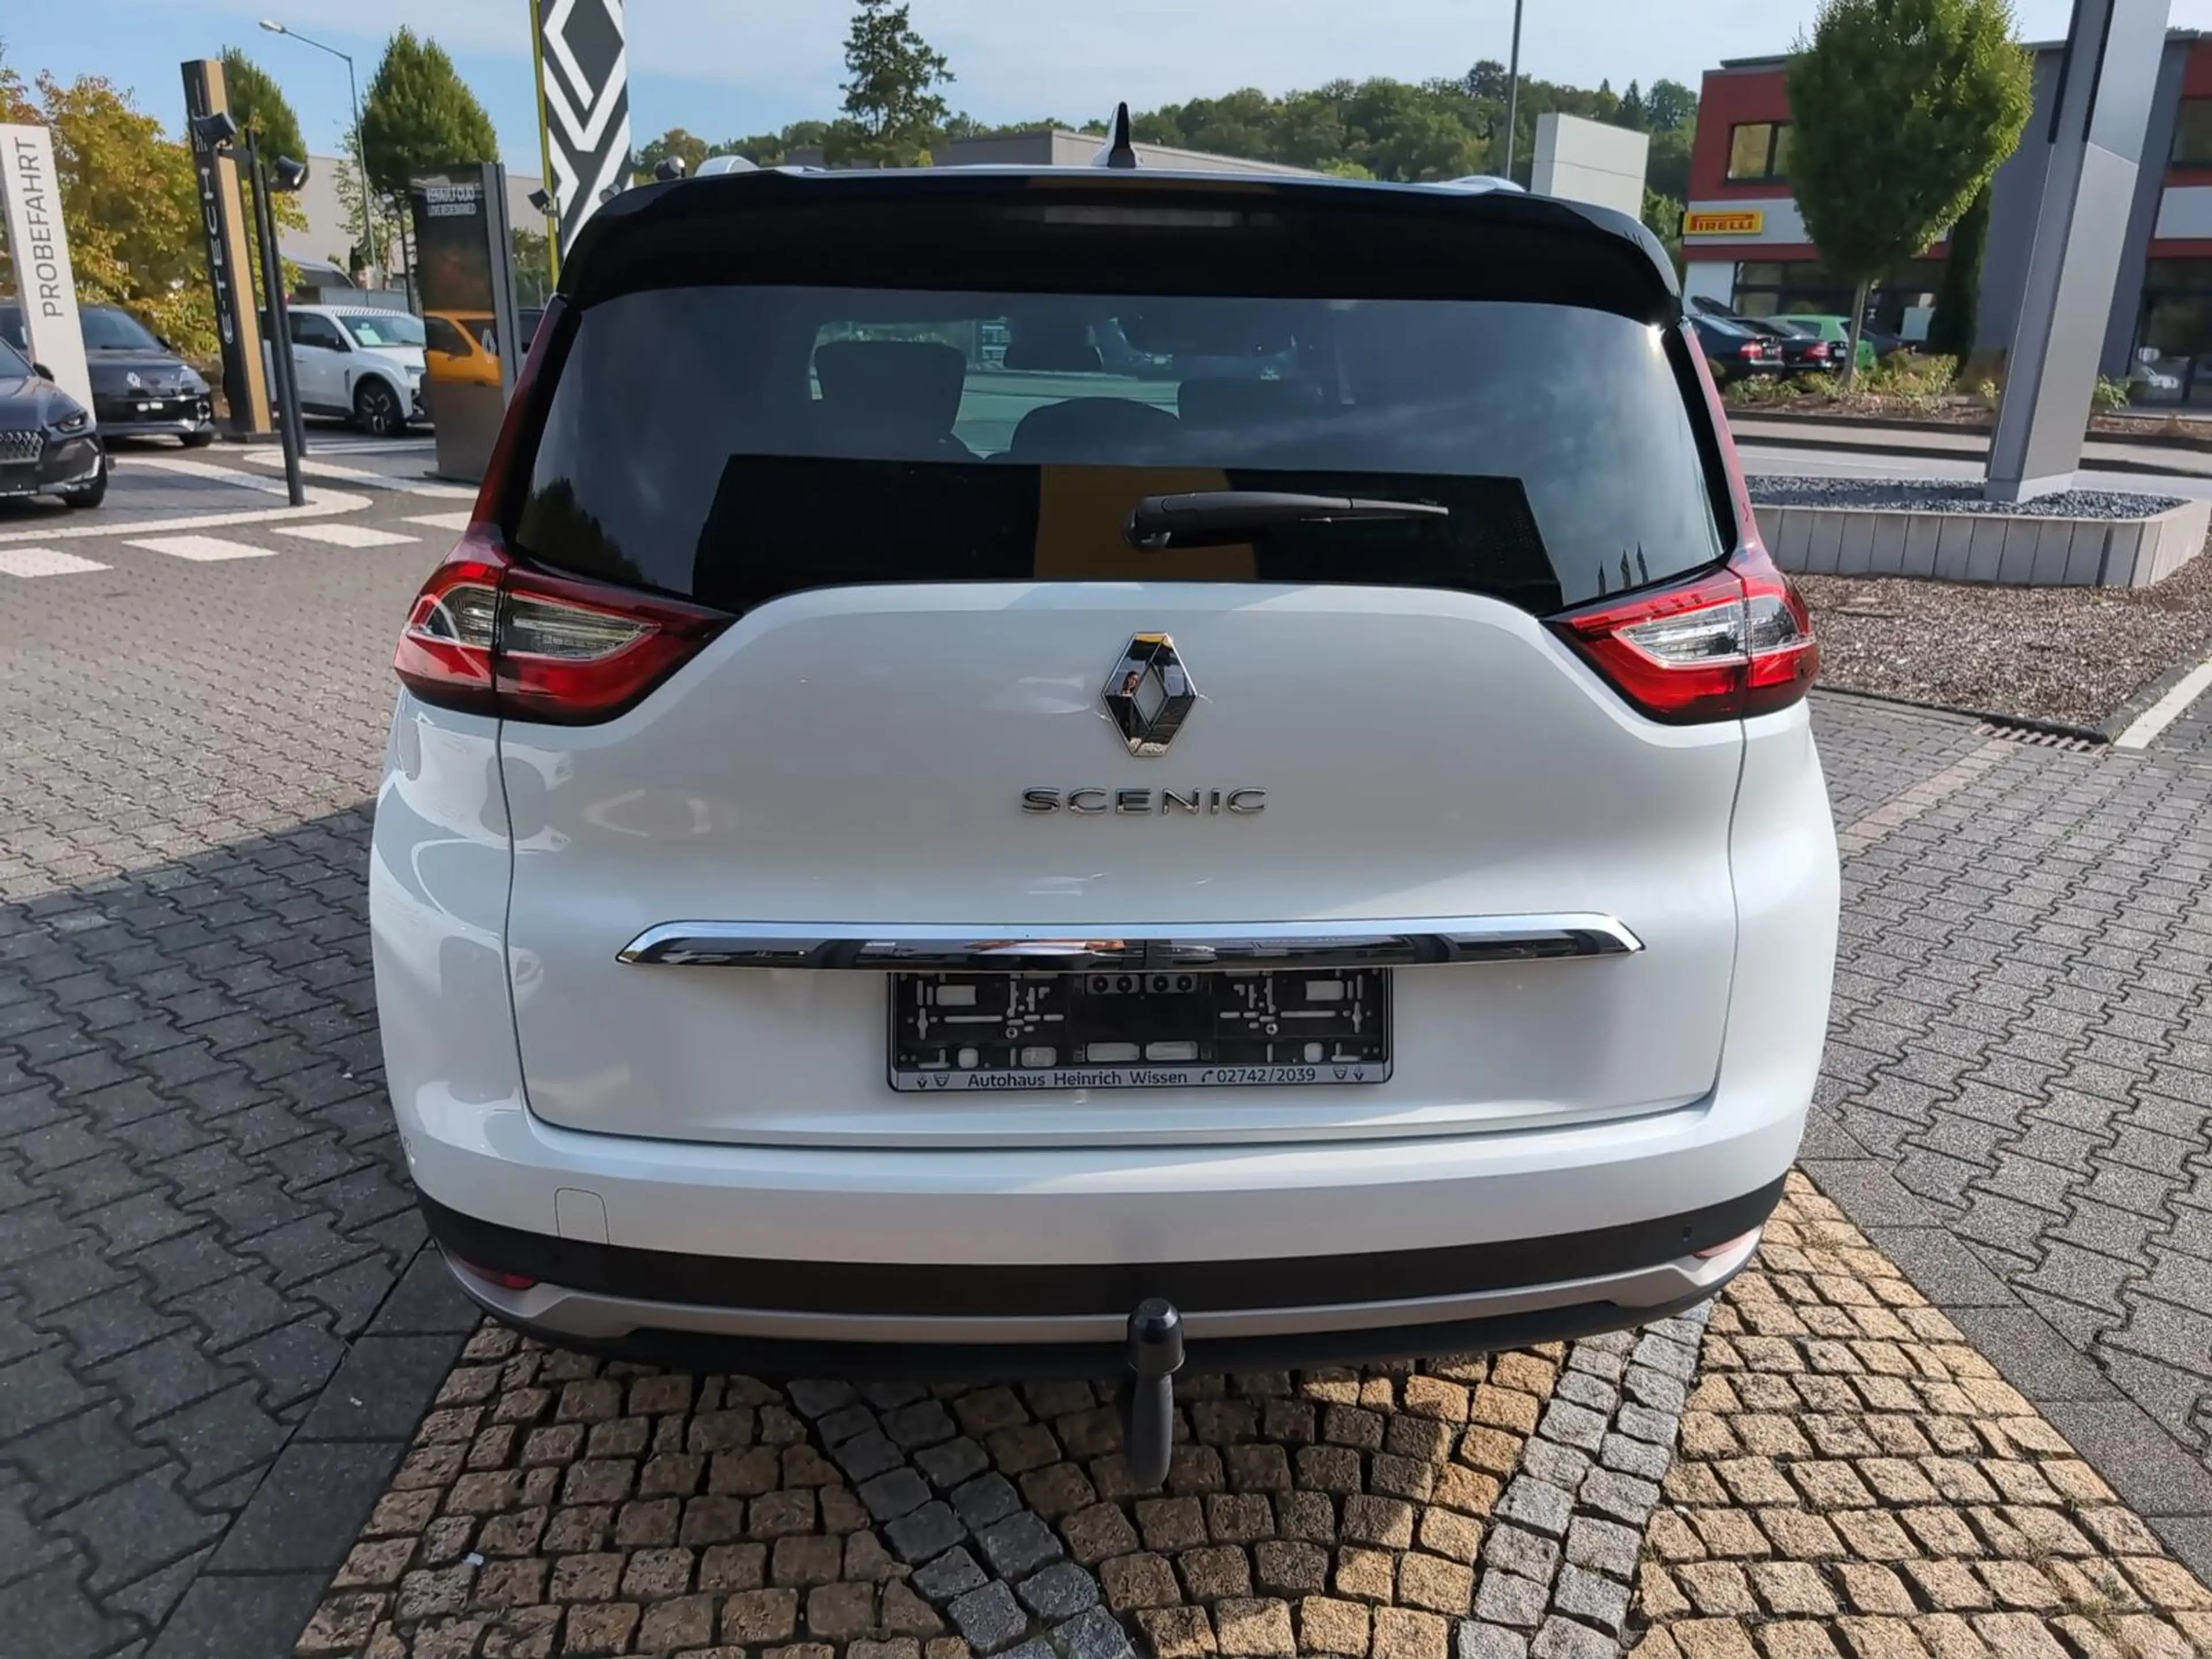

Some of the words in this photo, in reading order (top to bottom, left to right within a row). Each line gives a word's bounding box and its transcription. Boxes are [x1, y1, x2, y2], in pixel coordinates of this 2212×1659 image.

[14, 136, 65, 318] PROBEFAHRT
[1689, 214, 1755, 231] PIRELLI
[1021, 786, 1268, 816] SCENIC
[967, 1072, 1046, 1088] Autohaus
[1054, 1070, 1122, 1086] Heinrich
[1129, 1070, 1188, 1084] Wissen
[1216, 1067, 1316, 1084] 02742/2039
